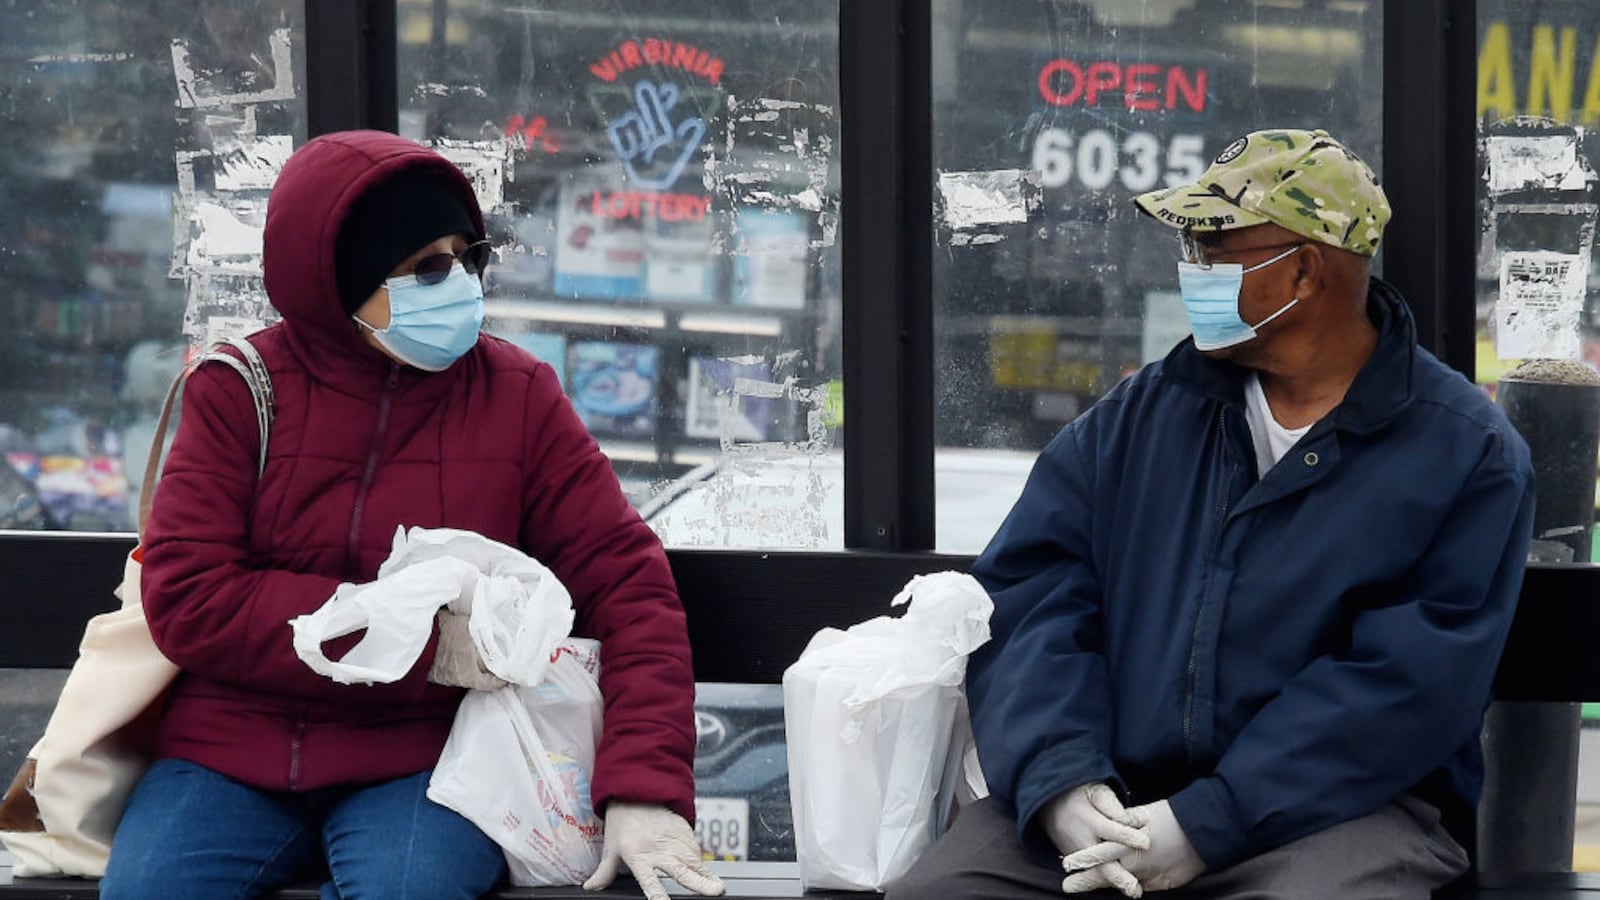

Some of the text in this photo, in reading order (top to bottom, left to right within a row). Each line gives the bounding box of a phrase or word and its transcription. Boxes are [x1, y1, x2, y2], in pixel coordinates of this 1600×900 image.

[589, 37, 725, 85] VIRGINIA
[1038, 58, 1207, 112] OPEN
[1032, 128, 1205, 191] 6035
[591, 190, 711, 223] LOTTERY
[1157, 207, 1236, 227] REDSKINS
